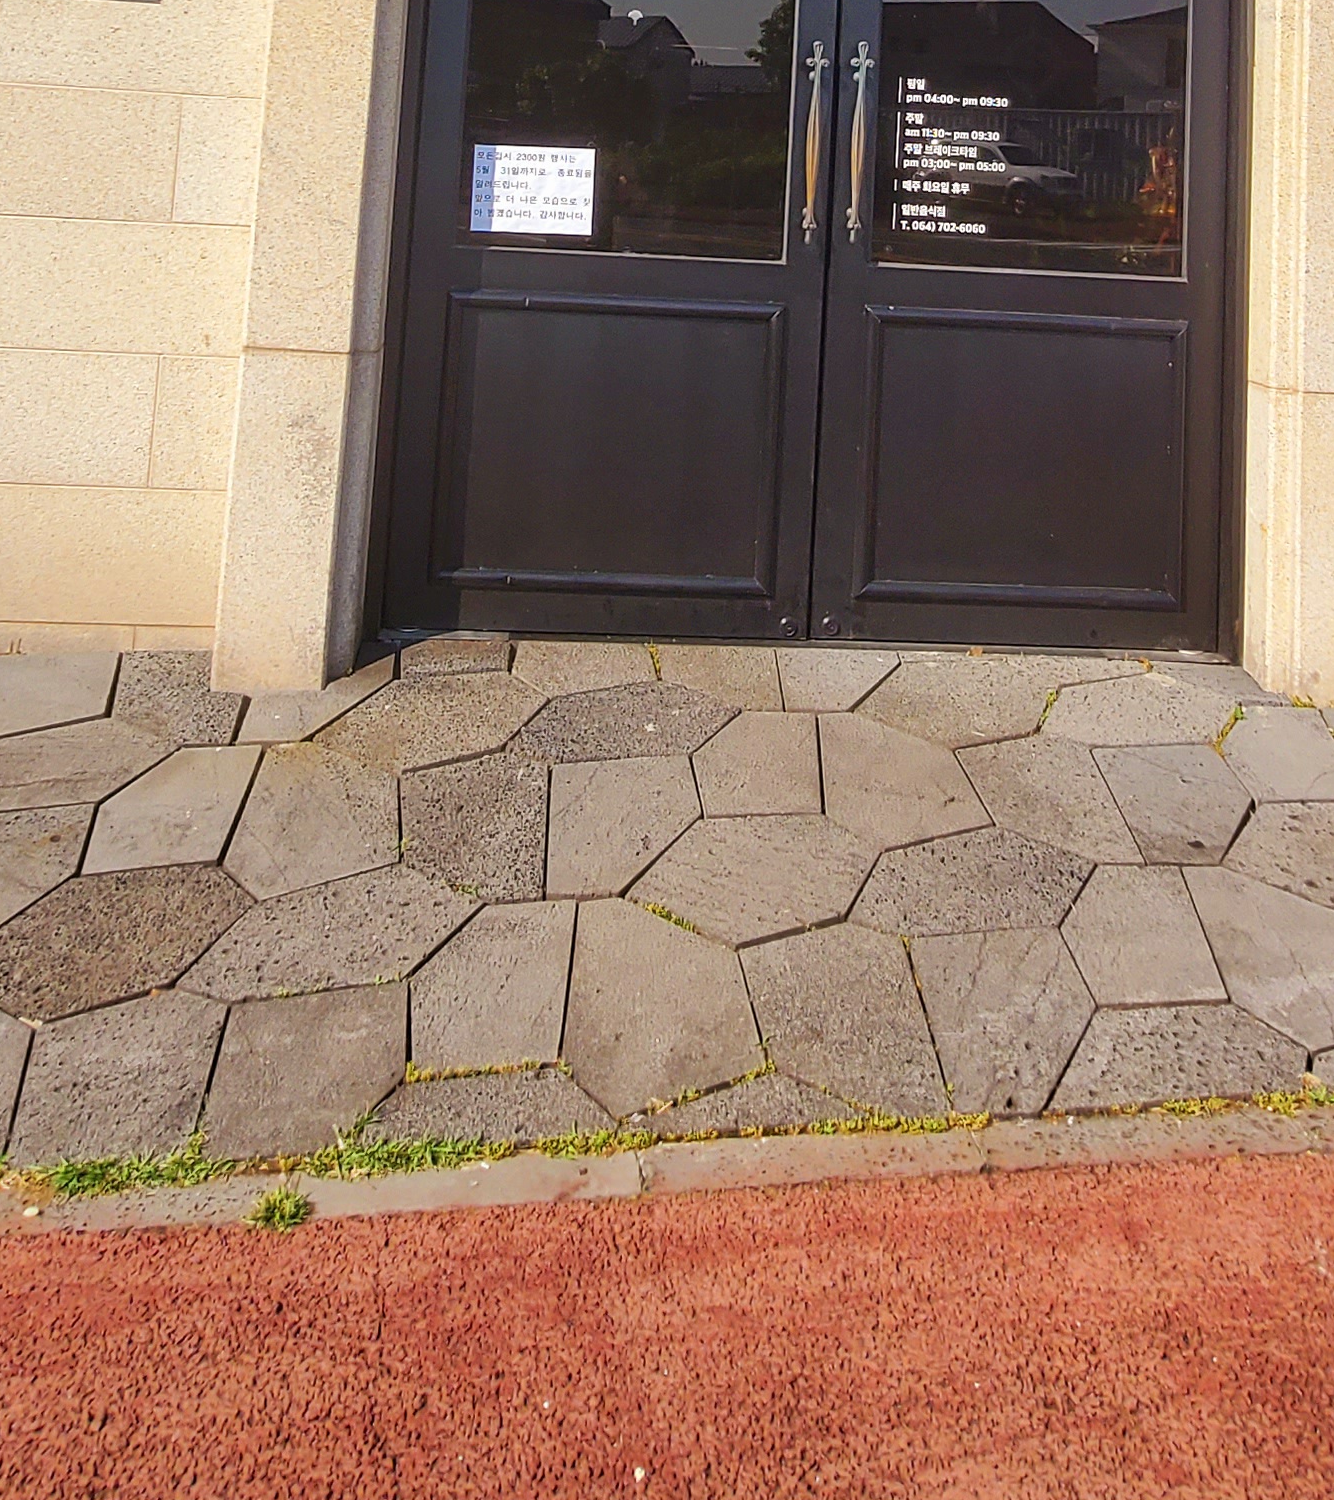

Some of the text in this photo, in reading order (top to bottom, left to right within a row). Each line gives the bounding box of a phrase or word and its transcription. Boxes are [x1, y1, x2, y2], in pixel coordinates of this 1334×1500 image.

[906, 93, 1009, 108] pm 04:00~ pm 09:30
[905, 112, 924, 125] 주말
[904, 128, 921, 137] am
[953, 131, 969, 141] pm
[971, 130, 1000, 142] 09:30
[903, 159, 919, 169] pm
[958, 162, 975, 172] pm
[976, 161, 1006, 172] 05:00
[900, 220, 986, 234] T. 064) 702-6060
